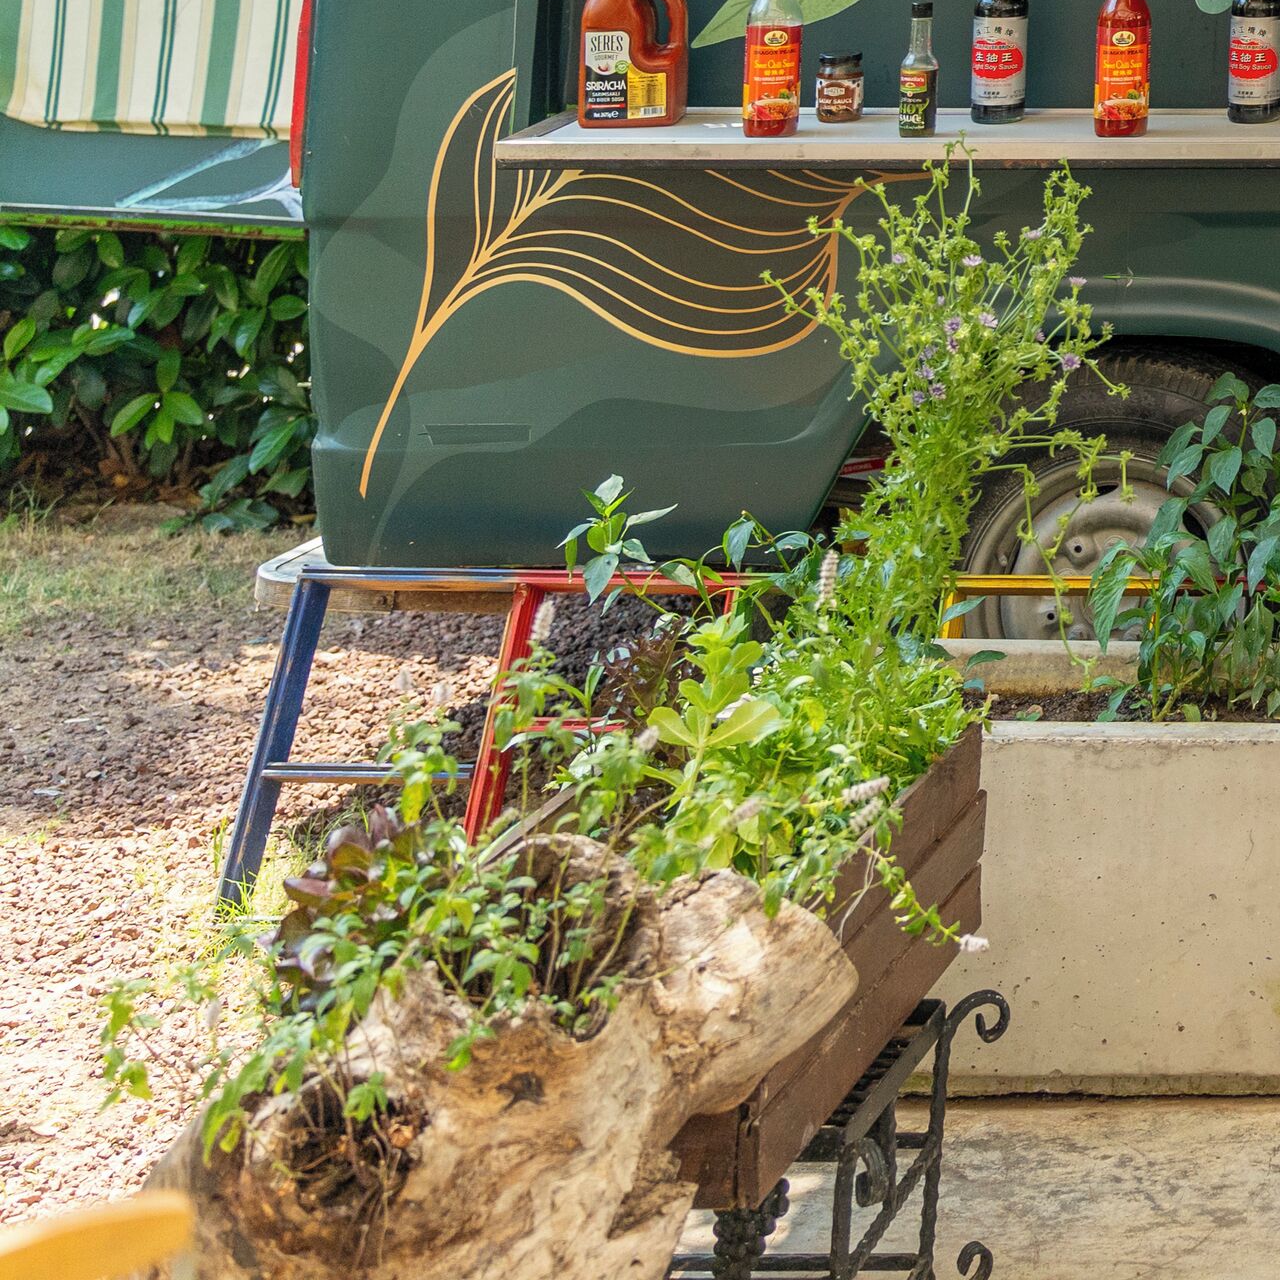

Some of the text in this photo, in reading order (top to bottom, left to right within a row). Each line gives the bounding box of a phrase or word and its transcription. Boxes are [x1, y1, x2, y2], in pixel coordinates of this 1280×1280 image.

[591, 34, 623, 52] SERES
[975, 51, 1014, 63] 生抽王
[1231, 51, 1266, 63] 生抽王
[586, 80, 626, 91] SRIRACHA
